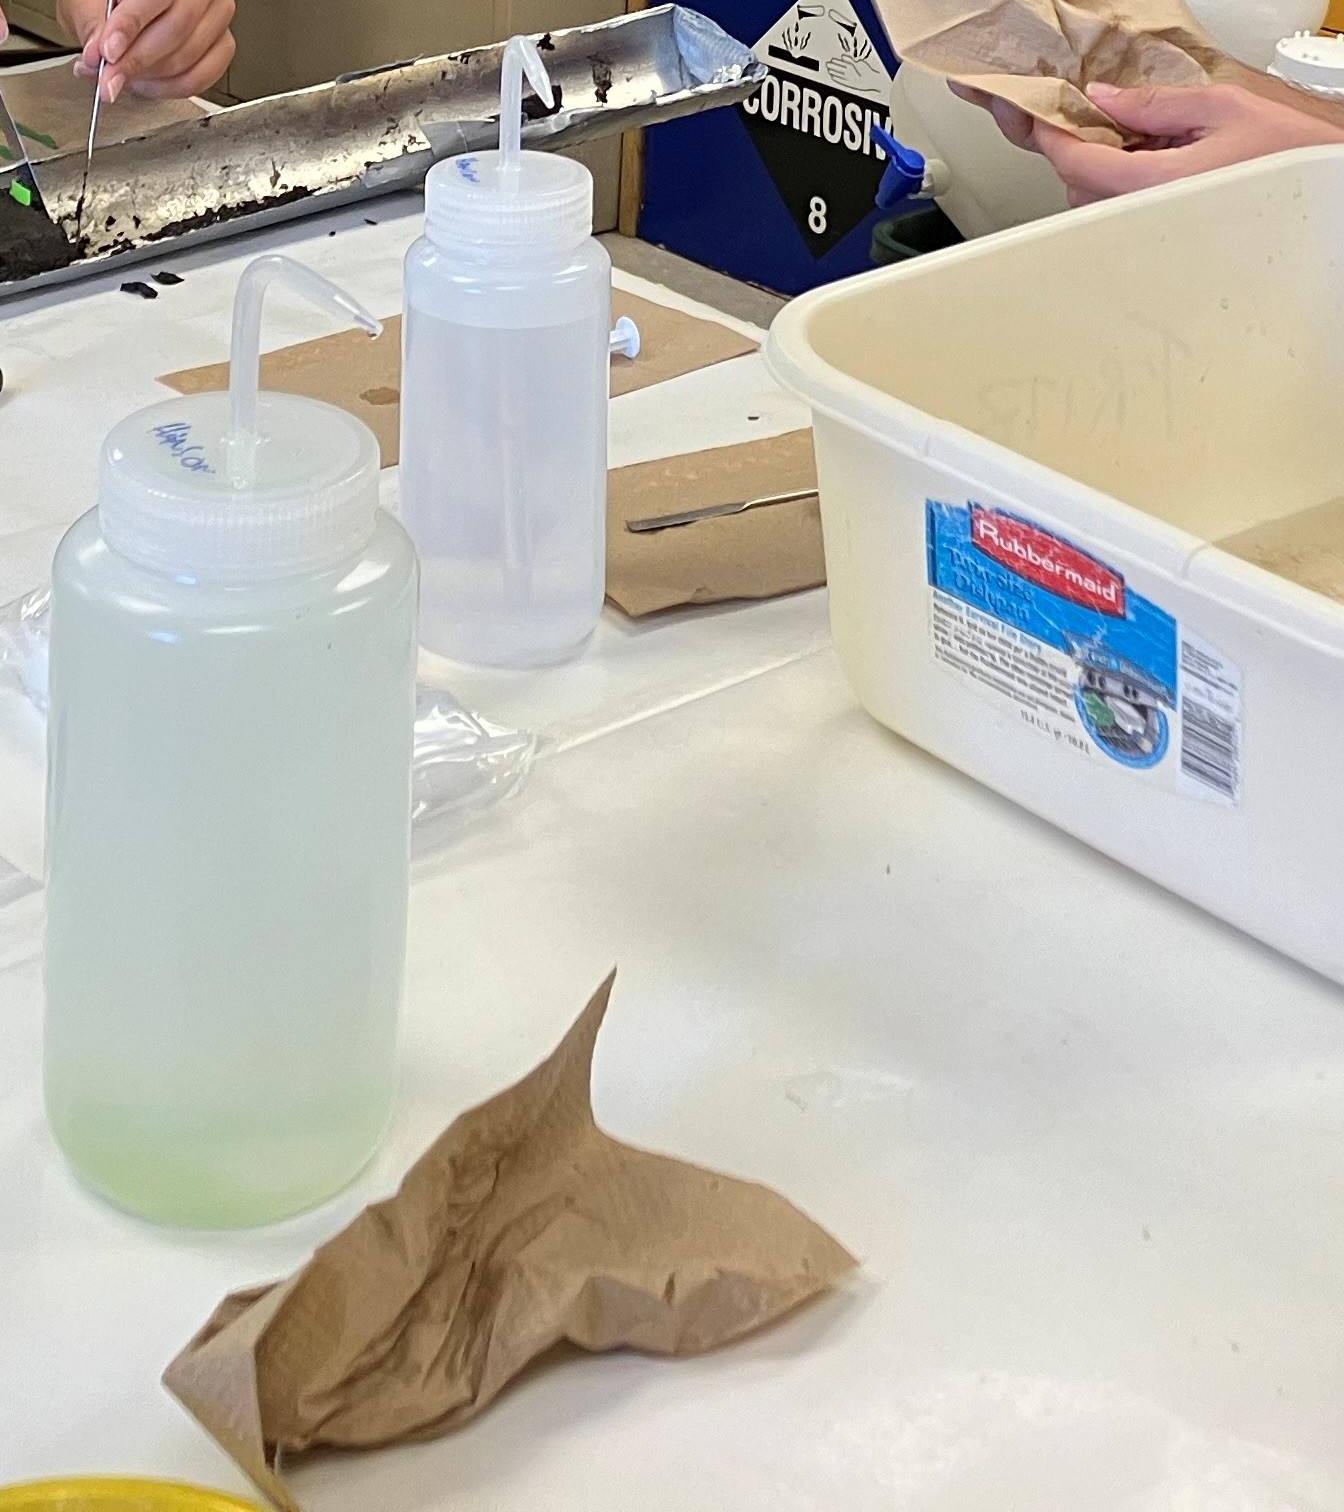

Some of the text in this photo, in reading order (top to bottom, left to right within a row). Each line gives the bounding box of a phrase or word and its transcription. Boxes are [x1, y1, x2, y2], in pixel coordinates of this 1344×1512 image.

[742, 74, 892, 161] ORROSIV
[807, 195, 828, 235] 8
[978, 518, 1117, 603] Rubbermaid
